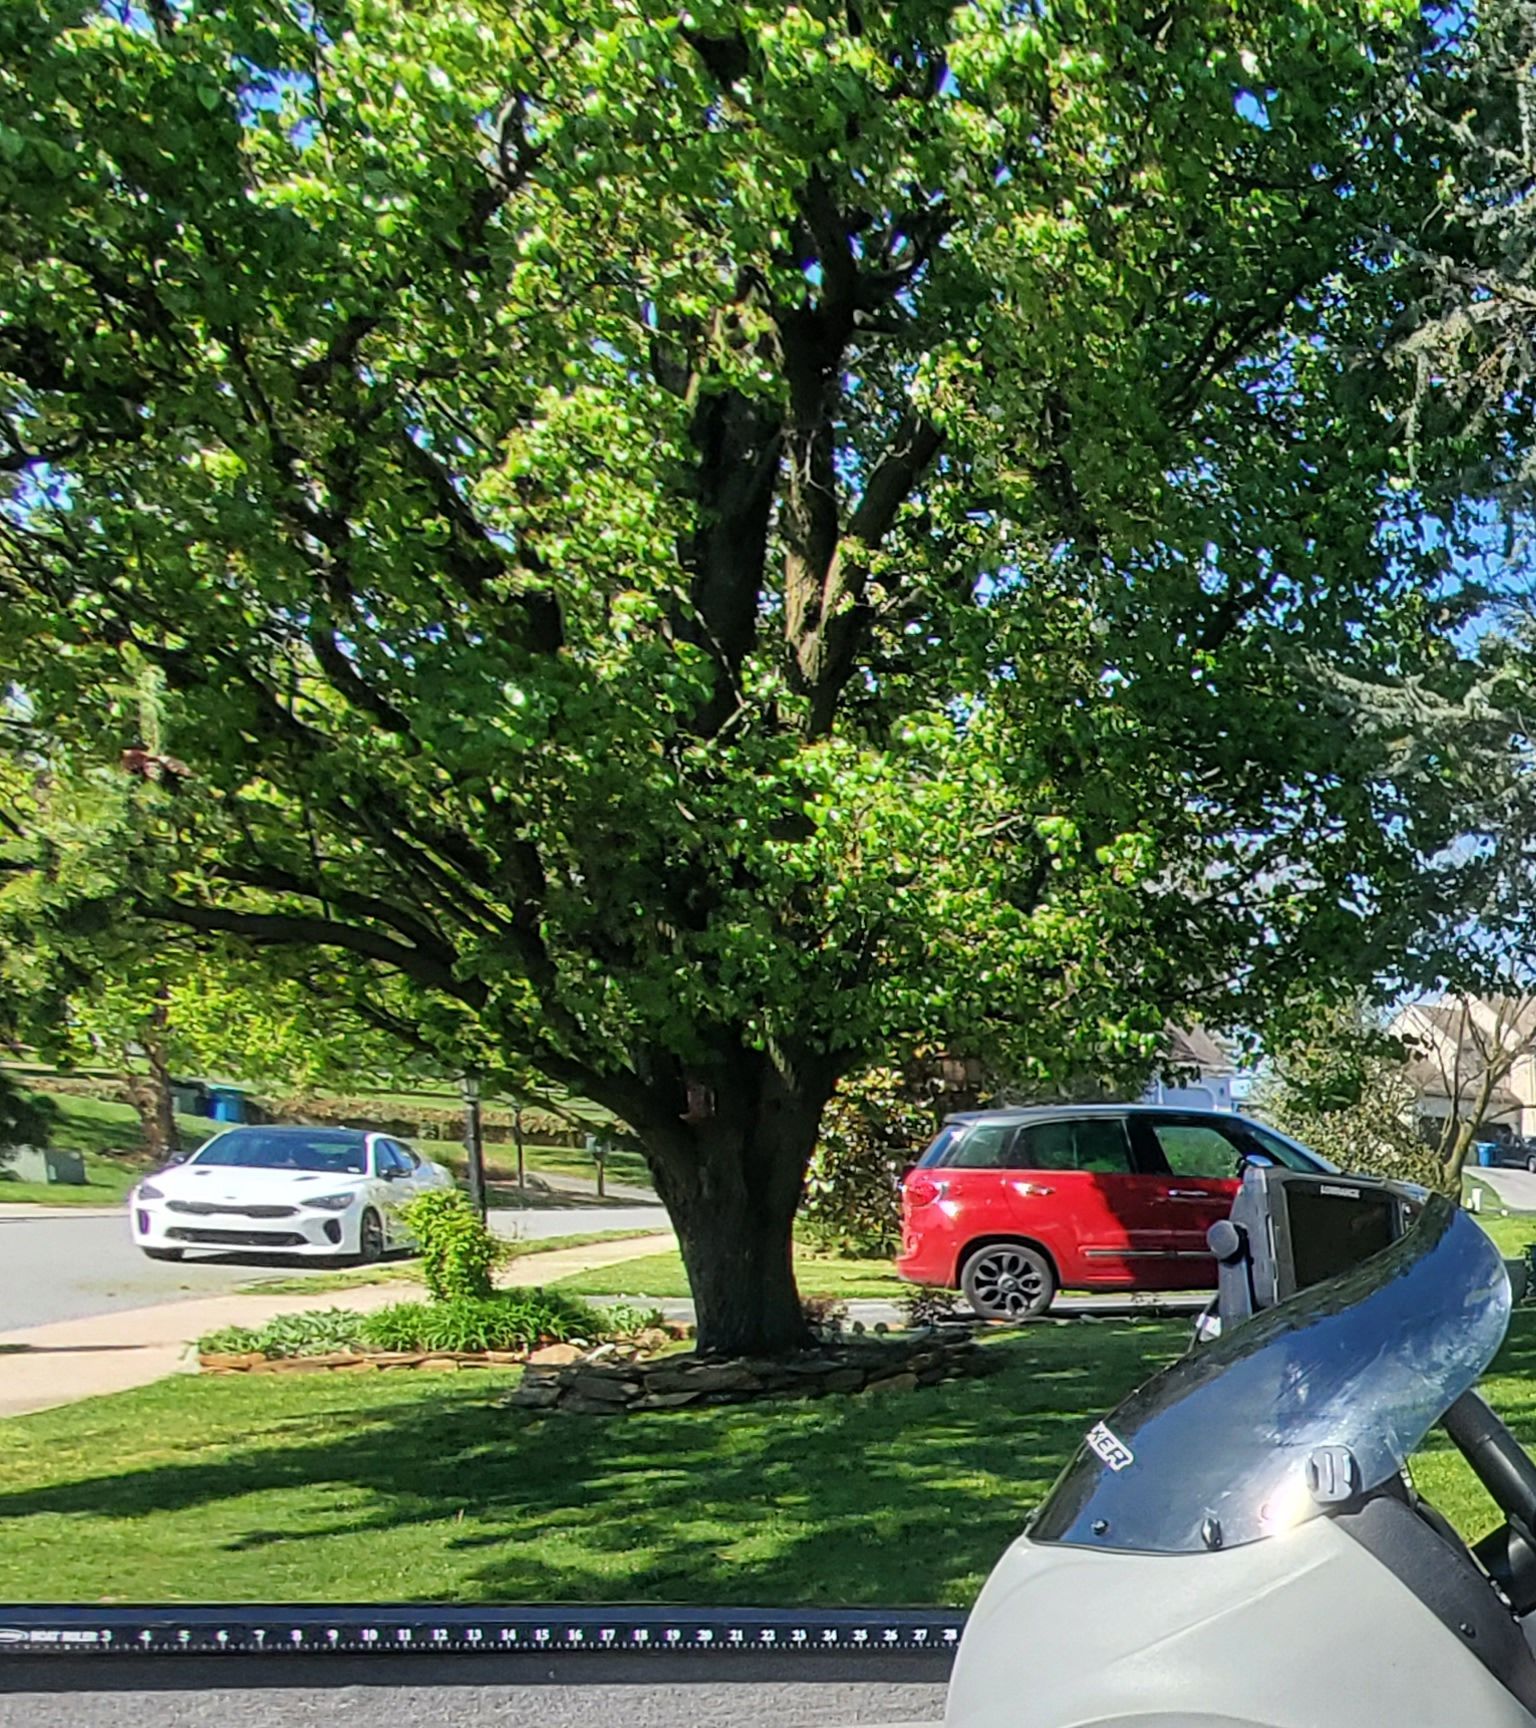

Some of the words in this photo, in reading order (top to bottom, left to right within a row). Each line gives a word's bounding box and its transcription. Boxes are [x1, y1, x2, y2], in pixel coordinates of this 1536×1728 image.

[100, 1629, 112, 1642] 3
[139, 1629, 151, 1641] 4
[178, 1629, 190, 1641] 5
[217, 1629, 229, 1641] 6
[254, 1629, 265, 1641] 7
[291, 1629, 302, 1641] 8
[328, 1629, 338, 1641] 9
[362, 1629, 378, 1641] 10
[398, 1629, 412, 1641] 11
[433, 1629, 449, 1641] 12
[467, 1629, 483, 1641] 13
[502, 1629, 517, 1641] 14
[535, 1629, 549, 1641] 15
[568, 1629, 583, 1641] 16
[602, 1629, 615, 1641] 17
[634, 1629, 648, 1641] 18
[667, 1629, 681, 1641] 19
[697, 1629, 712, 1641] 20
[729, 1629, 743, 1641] 21
[760, 1629, 775, 1641] 22
[791, 1629, 806, 1641] 23
[822, 1629, 837, 1641] 24
[853, 1629, 867, 1641] 25
[883, 1629, 898, 1641] 26
[913, 1629, 928, 1641] 27
[942, 1629, 958, 1641] 28
